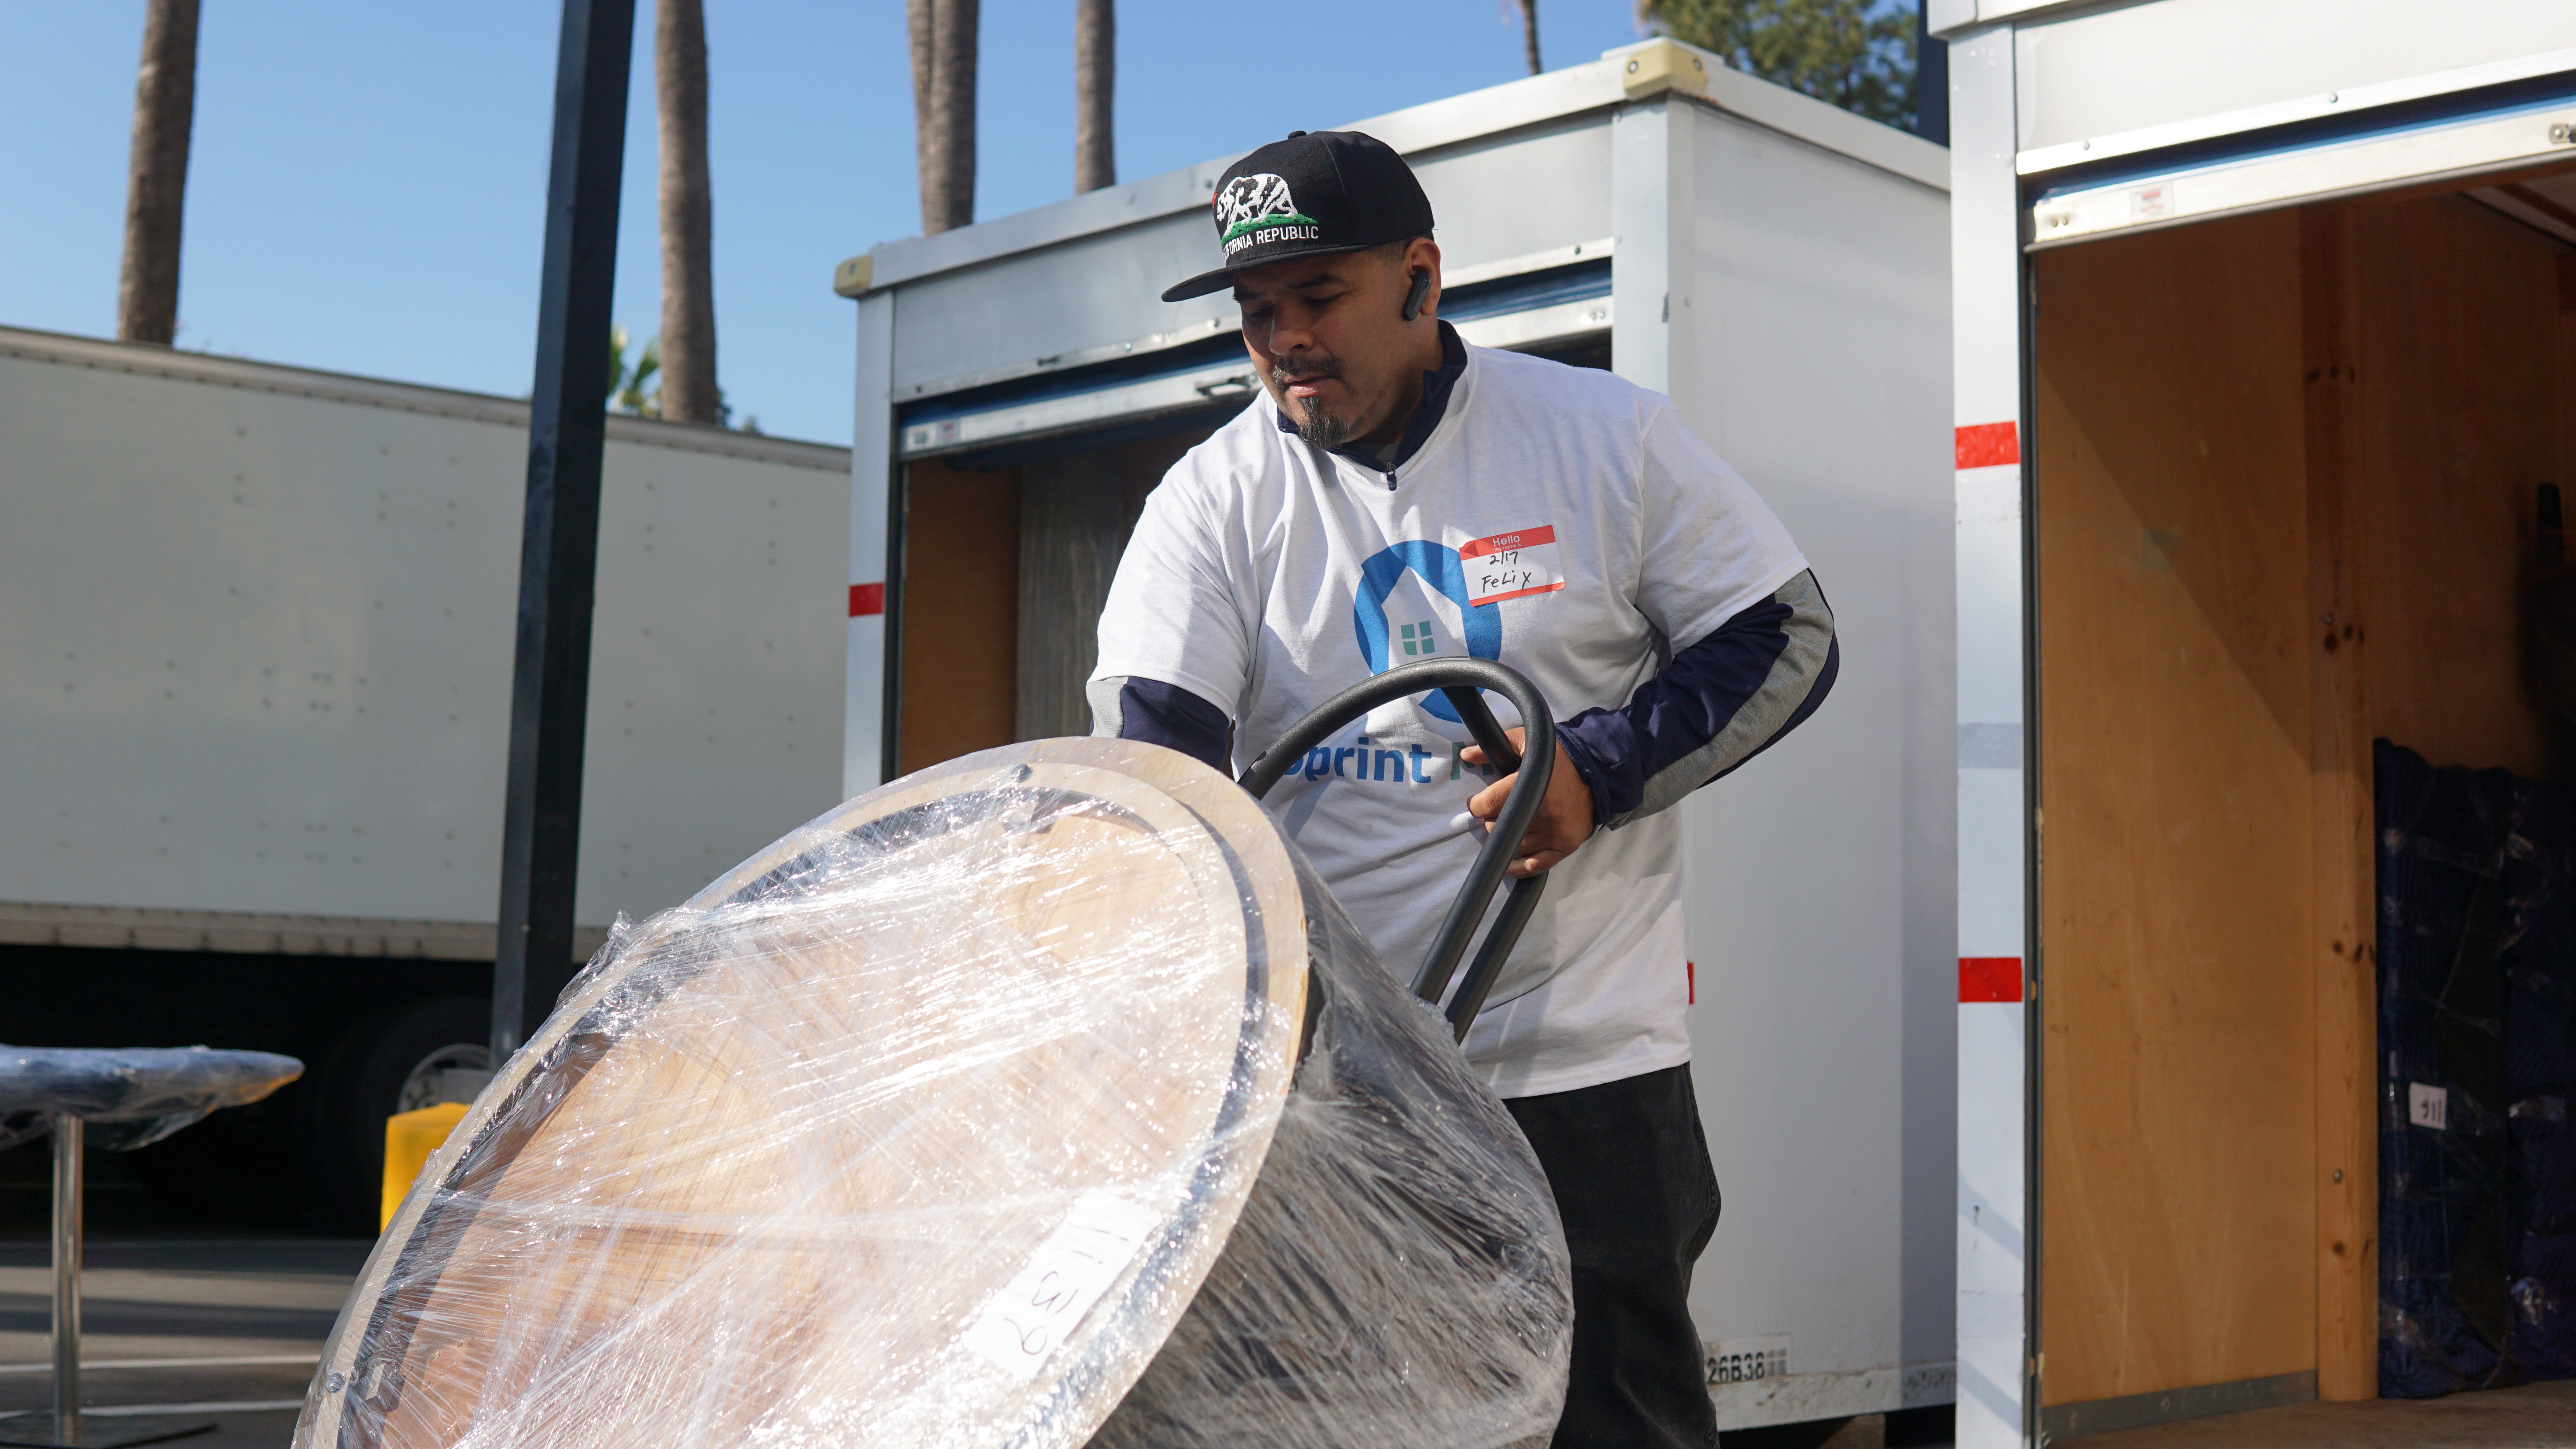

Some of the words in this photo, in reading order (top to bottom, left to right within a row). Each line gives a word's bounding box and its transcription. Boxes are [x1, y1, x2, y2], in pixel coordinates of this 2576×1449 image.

[1256, 226, 1319, 245] REPUBLIC
[1492, 535, 1520, 547] Hello
[1489, 551, 1519, 565] 2/17
